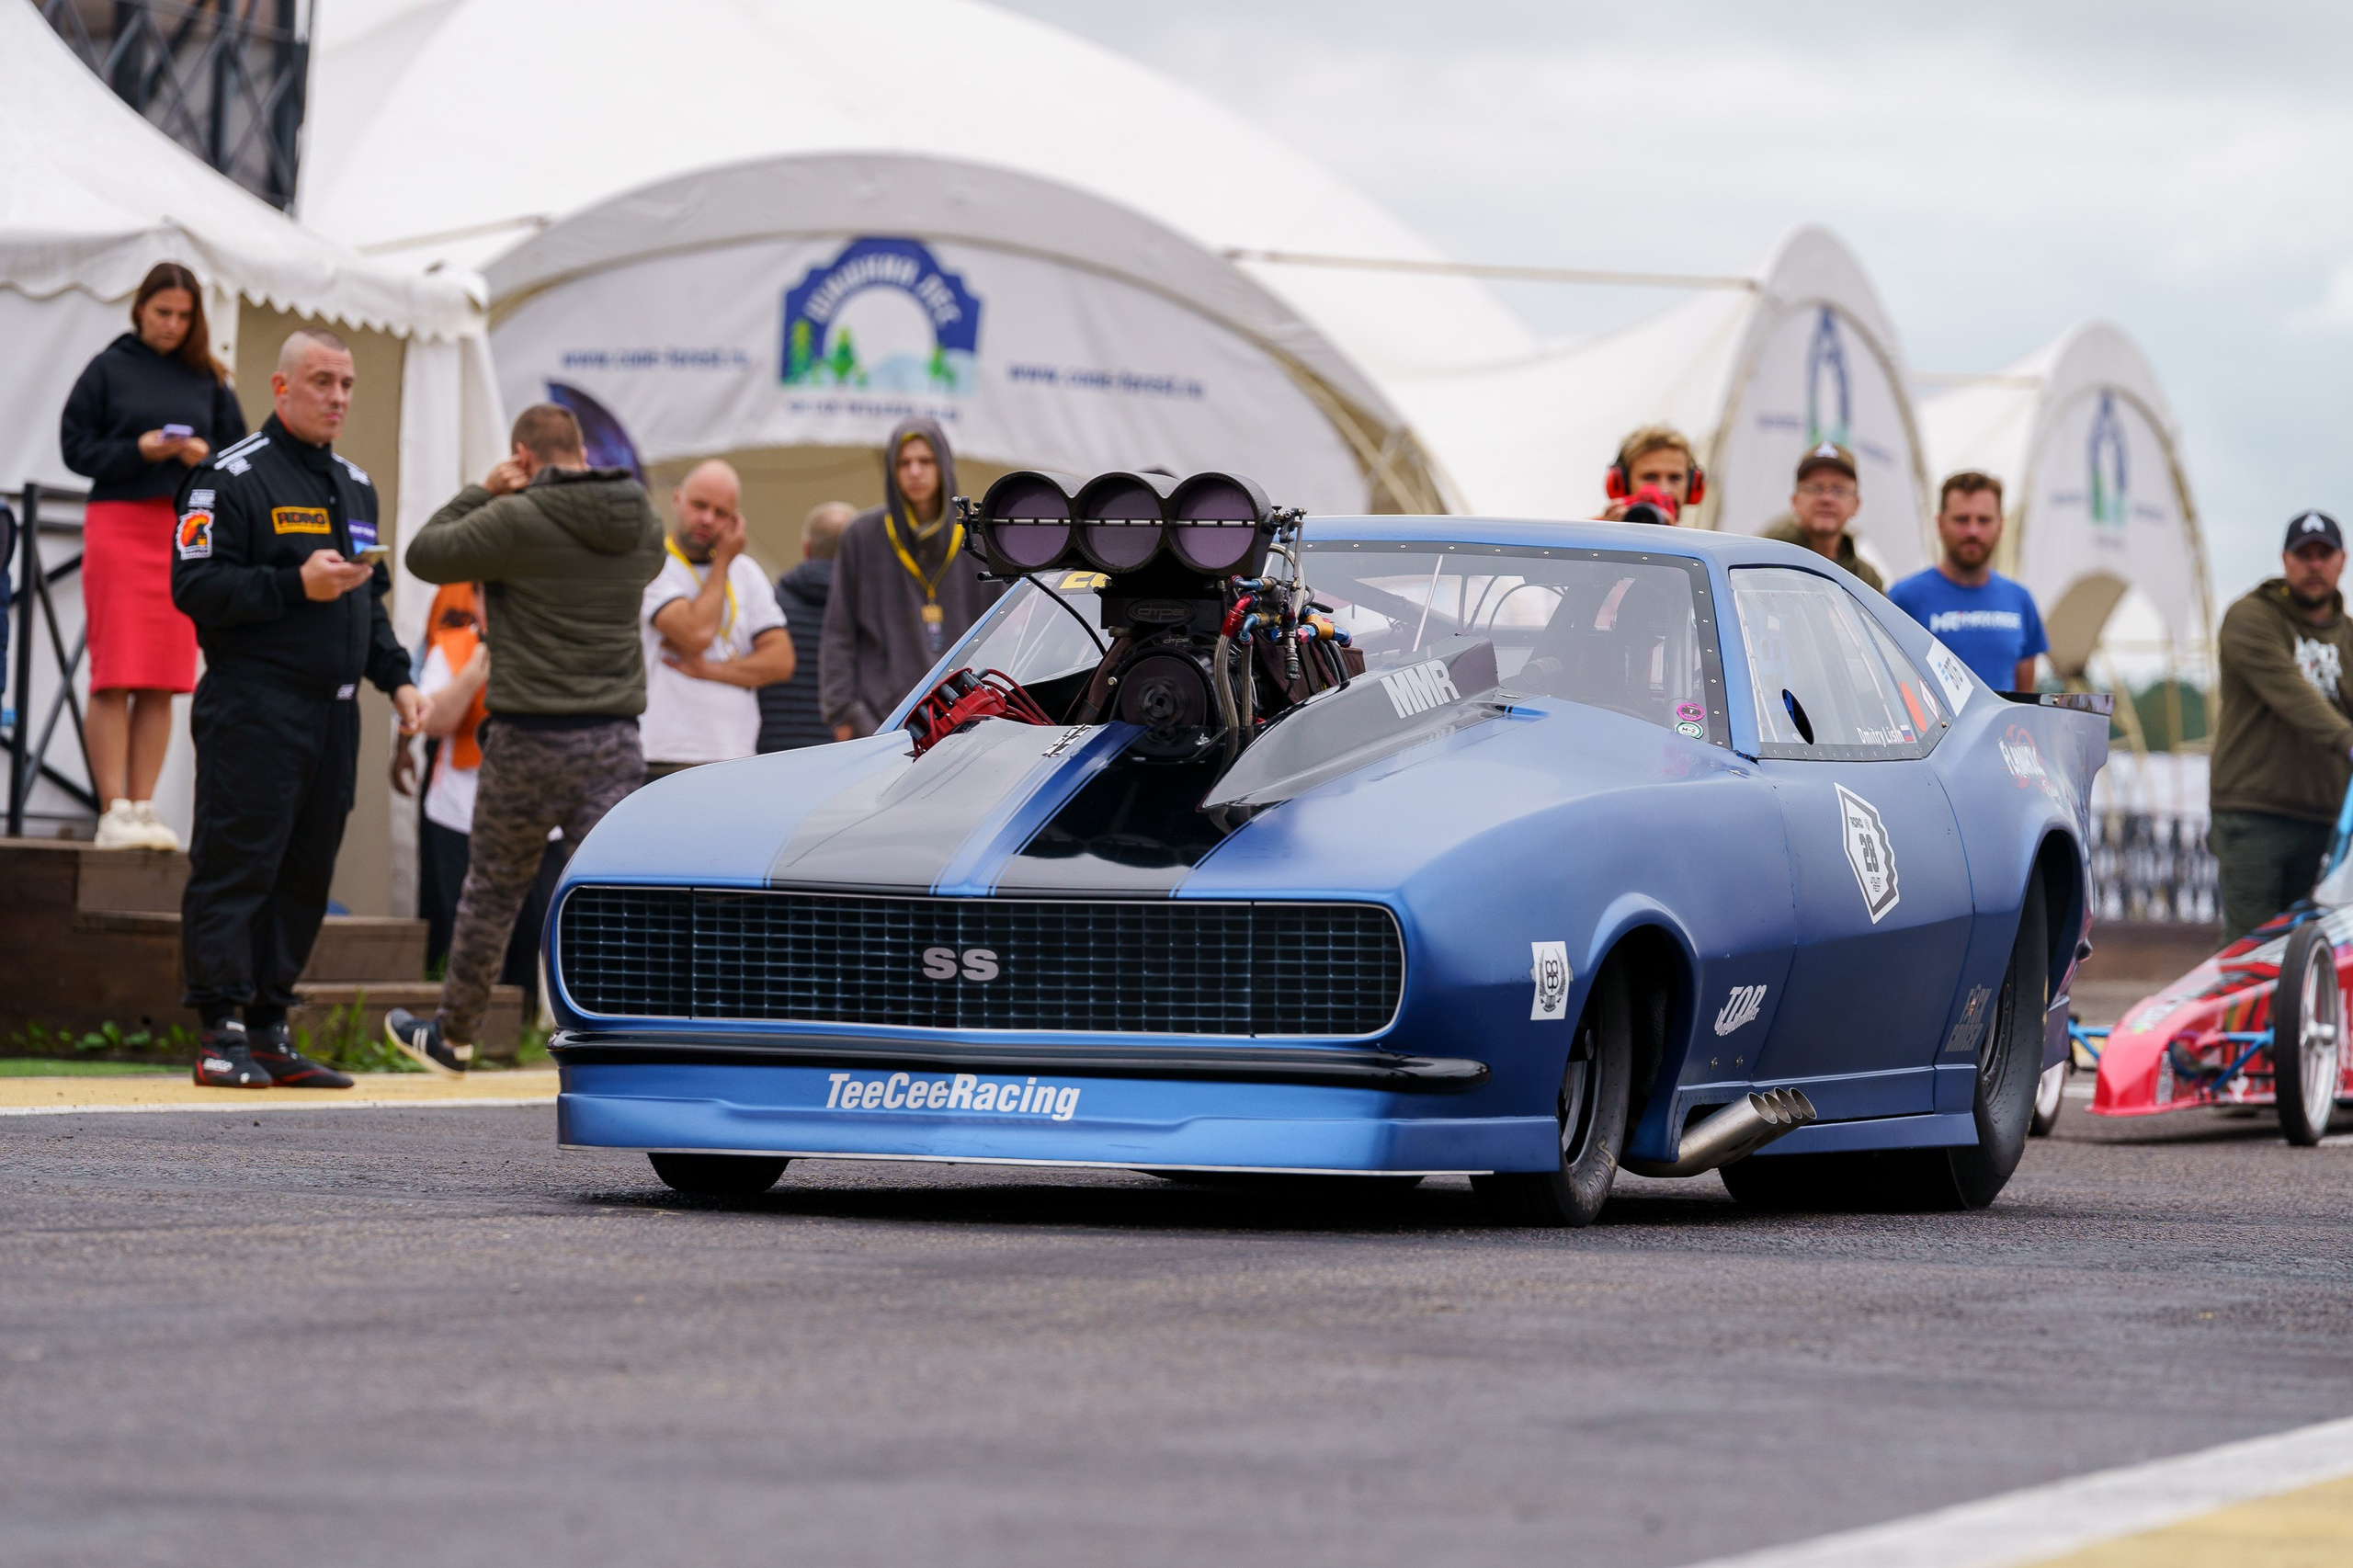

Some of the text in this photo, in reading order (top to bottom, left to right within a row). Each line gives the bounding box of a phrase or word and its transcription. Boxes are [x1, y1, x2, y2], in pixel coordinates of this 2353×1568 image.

[1380, 659, 1461, 719] MMR
[1857, 726, 1887, 748] Dmitry
[1859, 833, 1880, 873] 28
[922, 947, 1000, 982] SS
[1721, 984, 1768, 1025] TOP
[825, 1072, 1082, 1122] TeeCeeRacing
